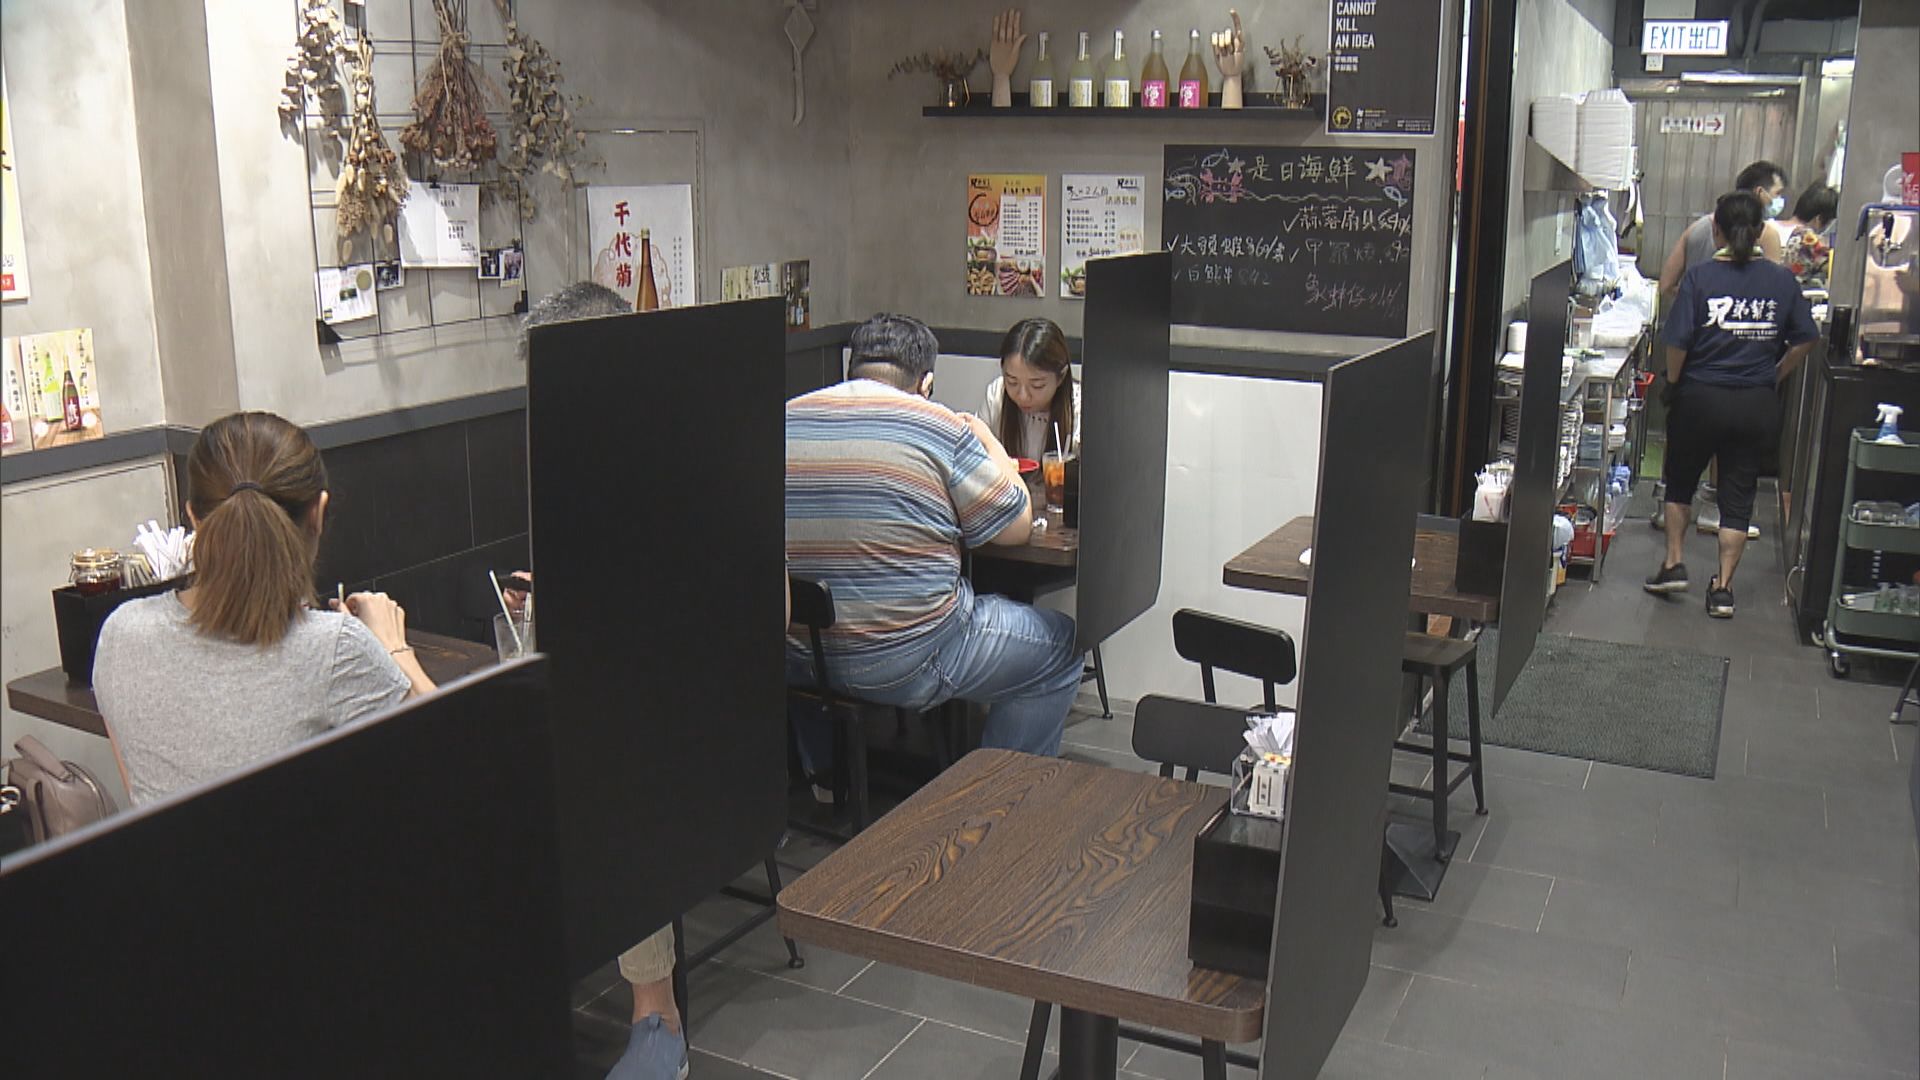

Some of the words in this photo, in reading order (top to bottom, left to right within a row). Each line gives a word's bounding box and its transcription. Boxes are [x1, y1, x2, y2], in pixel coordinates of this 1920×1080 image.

[1336, 1, 1377, 16] CANNOT
[1335, 17, 1359, 32] KILL
[1335, 33, 1350, 49] AN
[1352, 33, 1375, 49] IDEA
[1650, 25, 1687, 49] EXIT
[1688, 25, 1721, 49] 出口
[1246, 153, 1357, 191] 是日海鮮
[614, 201, 632, 288] 千代菊
